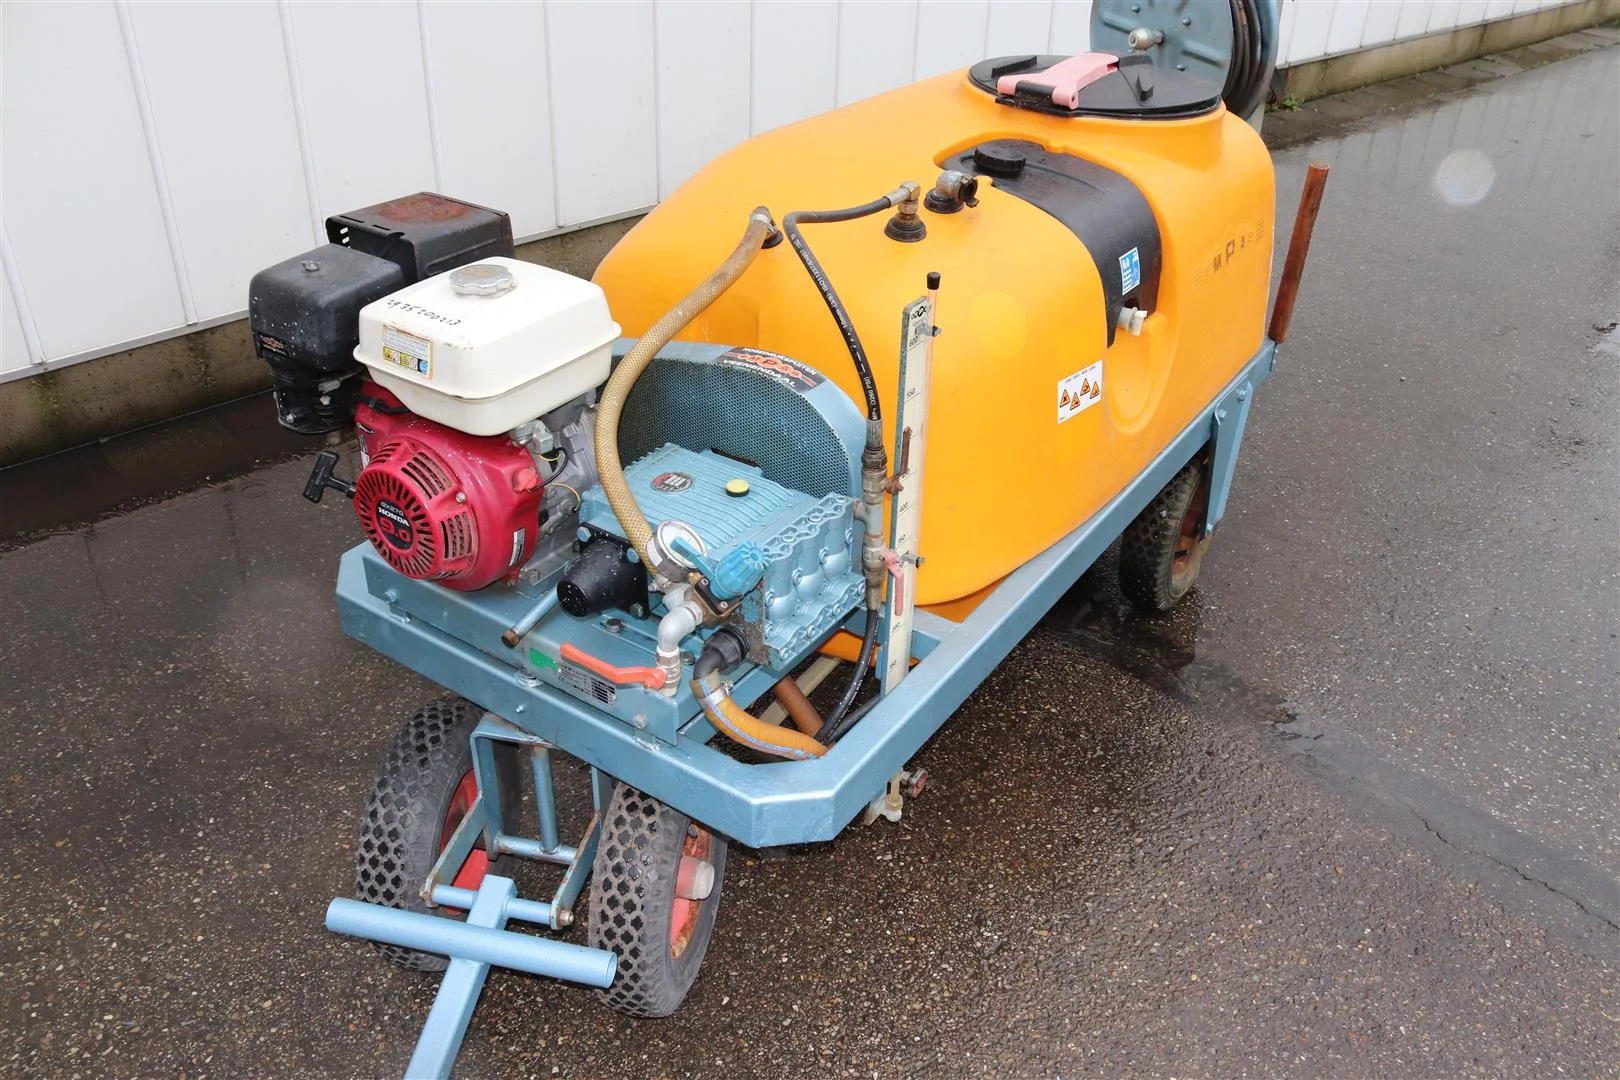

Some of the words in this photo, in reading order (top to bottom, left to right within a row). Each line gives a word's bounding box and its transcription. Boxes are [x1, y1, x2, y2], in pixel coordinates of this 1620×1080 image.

[723, 359, 797, 388] VEENENDAAL
[378, 507, 410, 527] HONDA
[380, 516, 411, 543] 9.0
